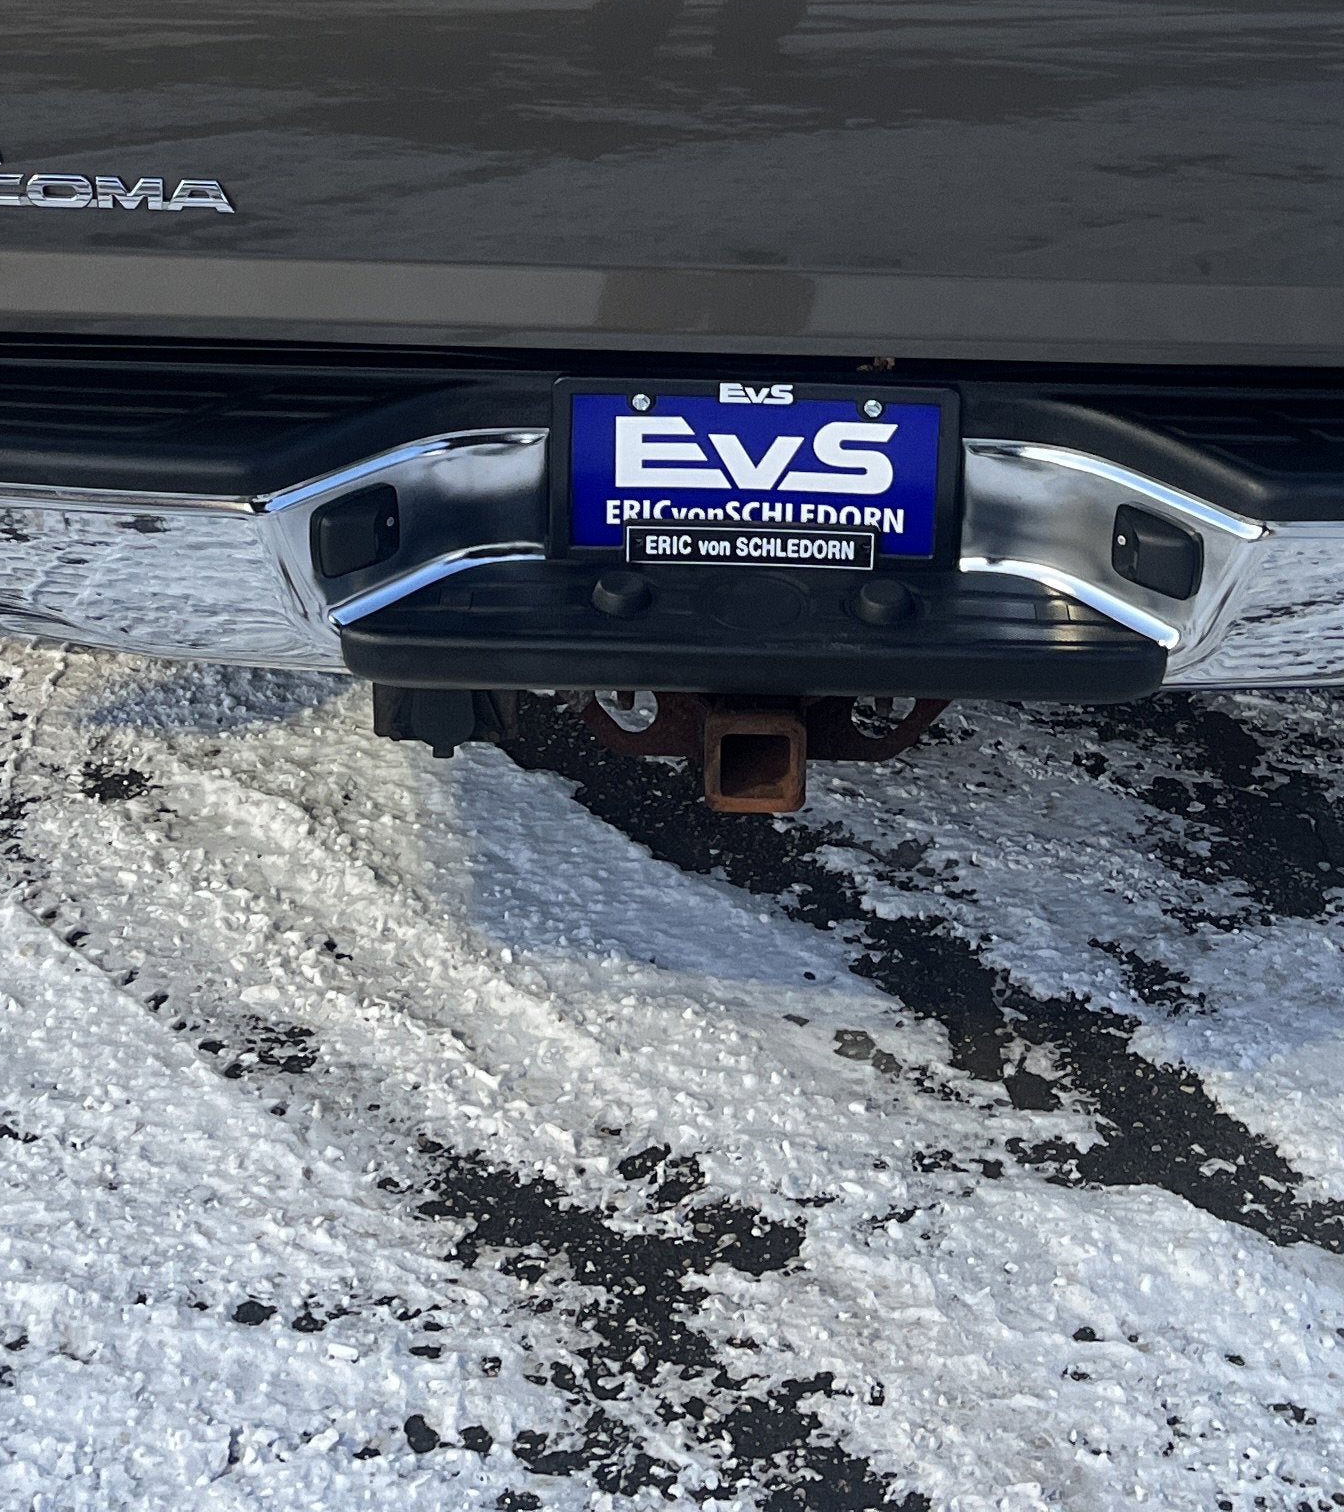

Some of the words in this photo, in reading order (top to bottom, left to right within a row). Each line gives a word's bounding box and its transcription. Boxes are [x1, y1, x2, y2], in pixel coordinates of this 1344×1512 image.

[645, 535, 692, 555] ERIC
[698, 539, 731, 556] von
[736, 538, 855, 560] SCHLEDORN
